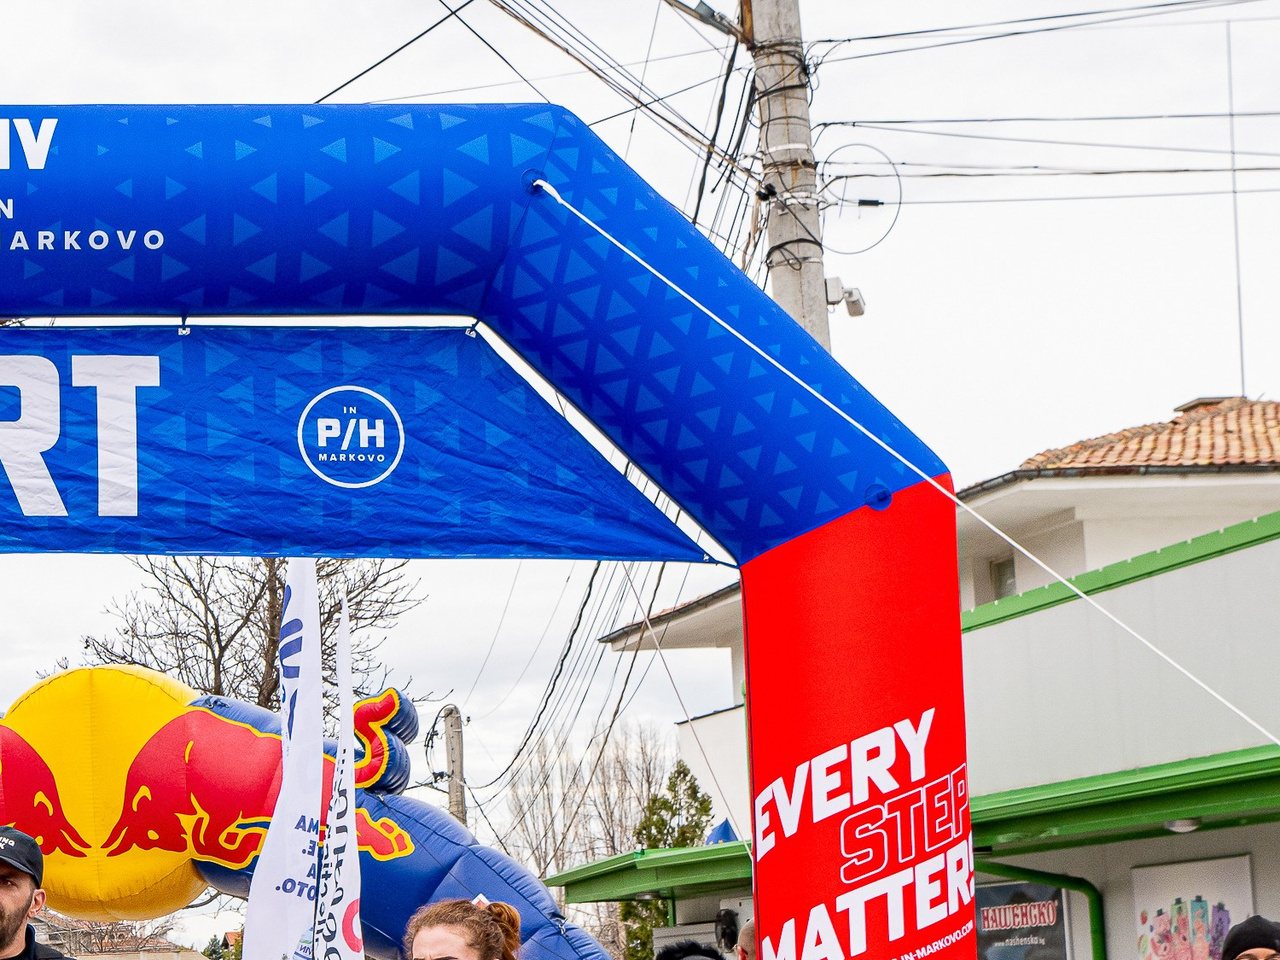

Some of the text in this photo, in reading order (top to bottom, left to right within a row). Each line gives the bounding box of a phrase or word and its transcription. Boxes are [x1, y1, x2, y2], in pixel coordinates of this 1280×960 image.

[343, 406, 357, 414] IN
[317, 418, 385, 451] P/H
[318, 453, 385, 462] MARKOVO
[755, 707, 936, 863] EVERY
[840, 762, 970, 884] STEP
